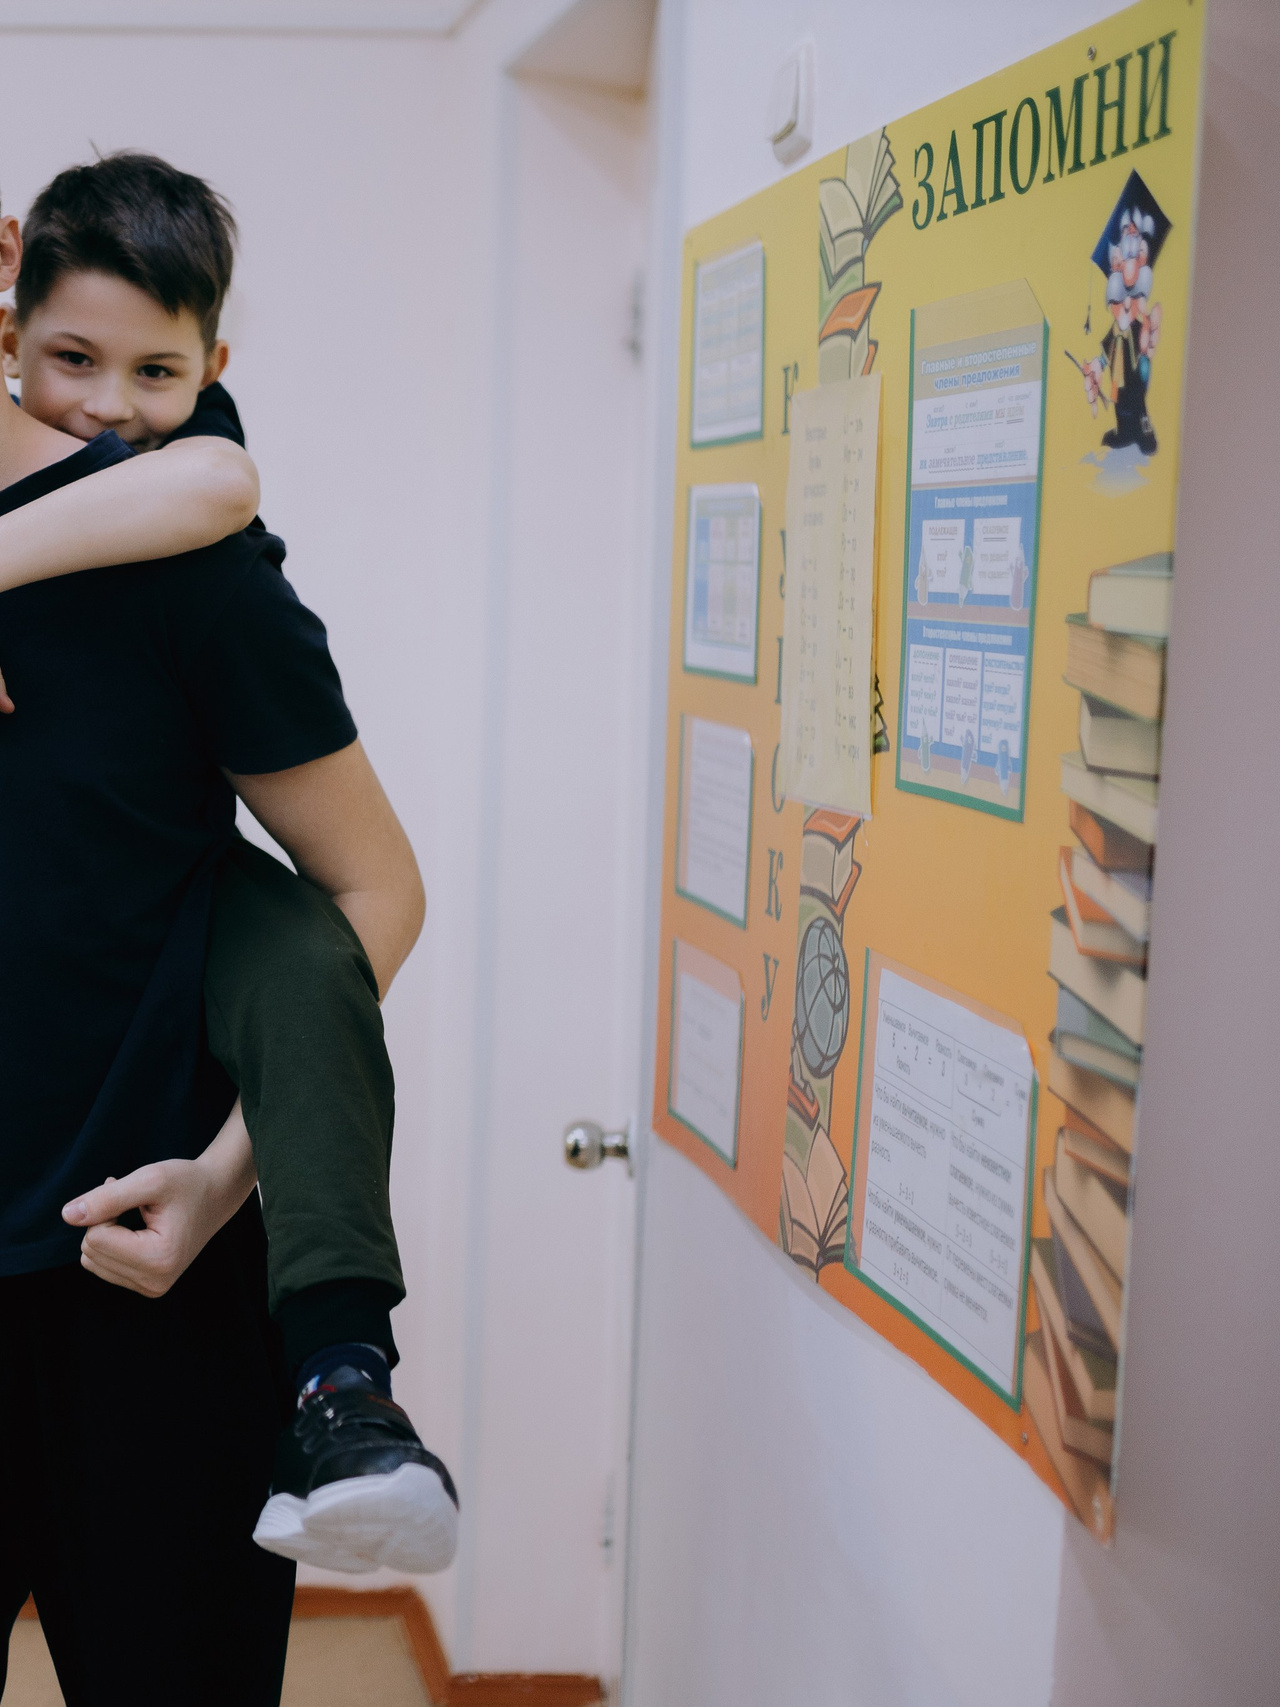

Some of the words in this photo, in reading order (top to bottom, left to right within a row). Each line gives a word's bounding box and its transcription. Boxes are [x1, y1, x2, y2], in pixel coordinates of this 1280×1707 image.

[912, 29, 1177, 230] ЗАПОМНИ
[921, 355, 955, 375] Главные
[957, 356, 962, 369] и
[964, 342, 1037, 370] второстепенные
[934, 377, 959, 389] члены
[962, 365, 1020, 388] предложения
[926, 412, 948, 430] Завтра
[954, 408, 993, 427] родителями
[995, 409, 1005, 419] мы
[919, 459, 927, 470] на
[929, 455, 975, 469] замечательное
[892, 1032, 896, 1048] 5
[914, 1045, 919, 1061] 2
